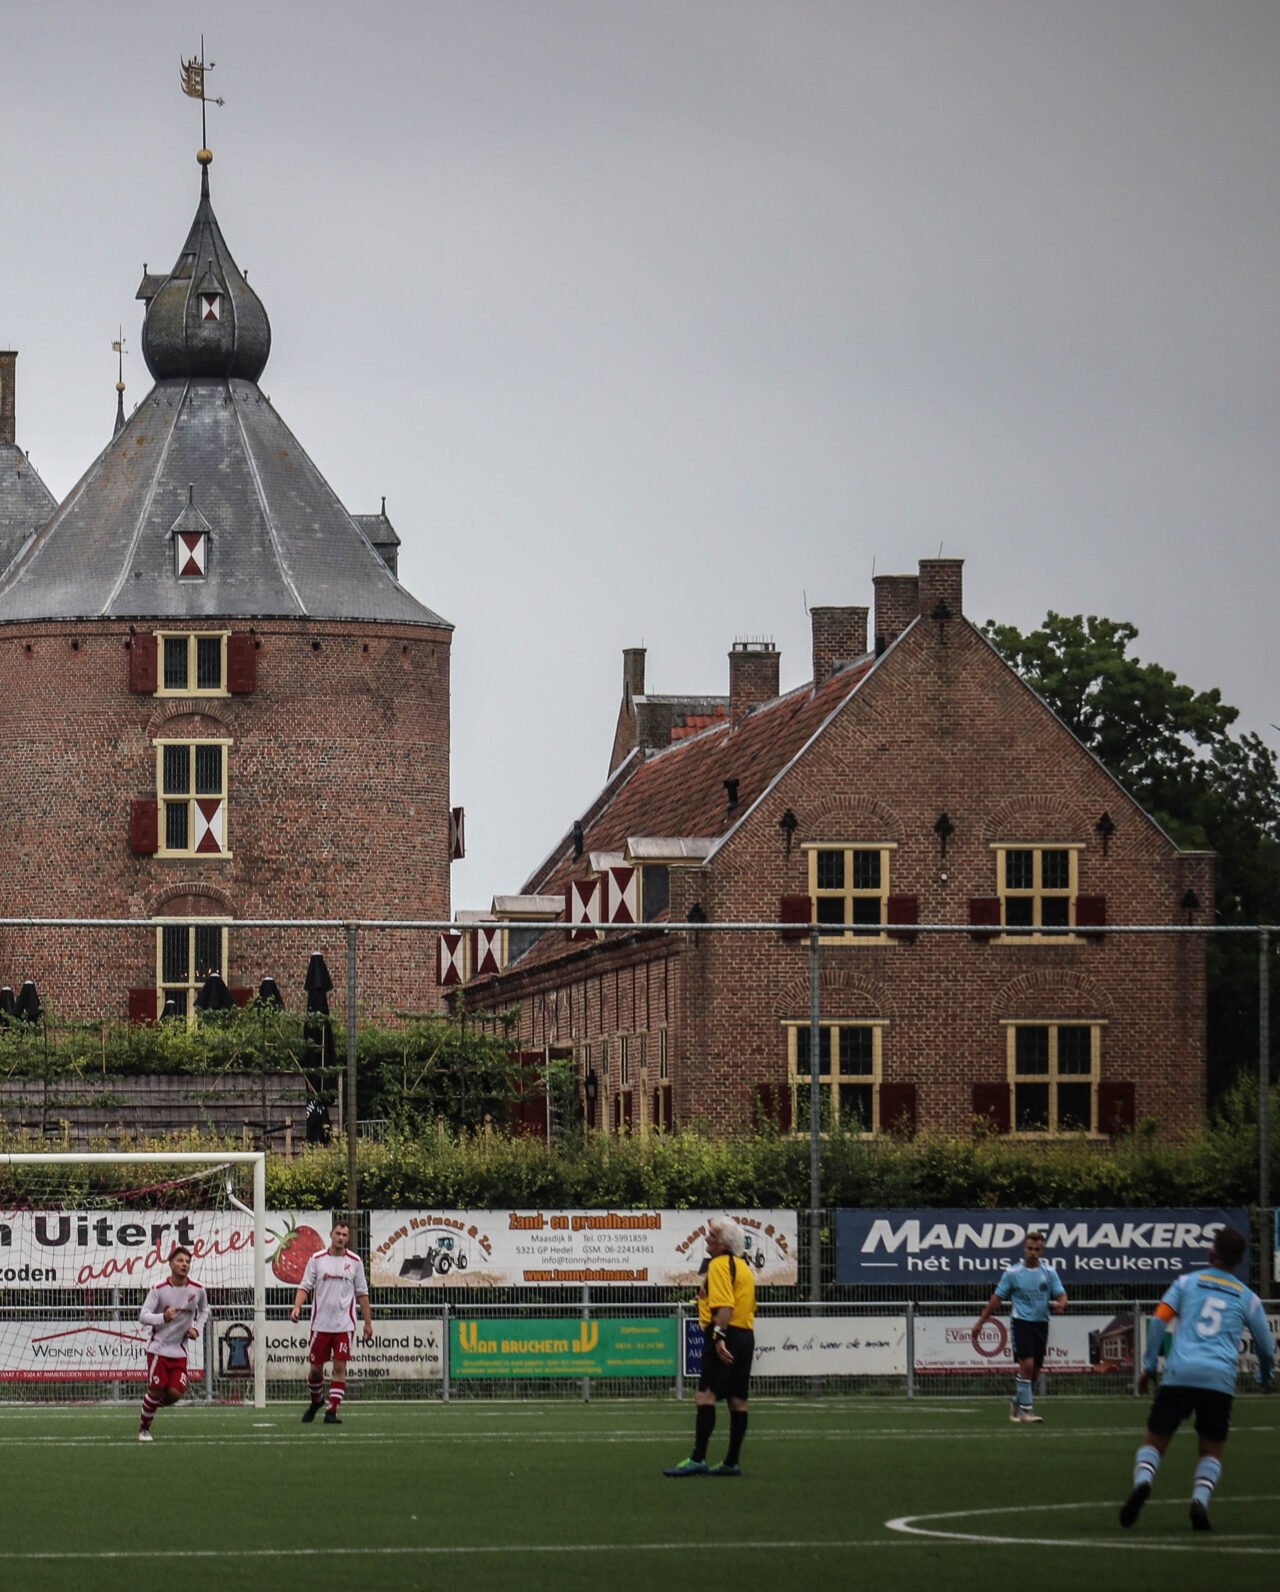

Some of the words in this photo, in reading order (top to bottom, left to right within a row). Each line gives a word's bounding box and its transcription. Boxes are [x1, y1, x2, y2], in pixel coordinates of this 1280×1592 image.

[508, 1212, 549, 1230] Zand-
[550, 1215, 570, 1229] en
[571, 1213, 662, 1231] grondhandel
[34, 1214, 195, 1247] Uitert
[376, 1225, 408, 1256] Tonny
[409, 1214, 466, 1231] Hofmans
[467, 1224, 480, 1239] &
[530, 1234, 566, 1245] Maasdijk
[567, 1234, 573, 1243] 8
[583, 1233, 596, 1243] Tel.
[597, 1233, 648, 1243] 073-5991859
[675, 1225, 706, 1256] Tonny
[516, 1246, 535, 1255] 5321
[537, 1246, 549, 1255] GP
[550, 1245, 574, 1255] Hedel
[582, 1246, 602, 1254] GSM.
[604, 1245, 655, 1254] 06-22414361
[541, 1256, 630, 1266] info@tonnyhofmans.nl
[907, 1255, 950, 1271] hét
[957, 1256, 1011, 1271] huis
[1075, 1256, 1183, 1271] keukens
[523, 1268, 649, 1283] www.tonnyhofmans.nl
[1196, 1297, 1228, 1338] 5
[356, 1335, 406, 1349] Holland
[413, 1335, 439, 1349] b.v.
[688, 1337, 704, 1345] van
[951, 1331, 970, 1341] Van
[979, 1330, 1001, 1341] den
[85, 1346, 96, 1358] &
[98, 1343, 148, 1362] Welzijn
[338, 1342, 348, 1354] 14
[1056, 1347, 1069, 1357] bv
[348, 1352, 439, 1363] achtschadeservice
